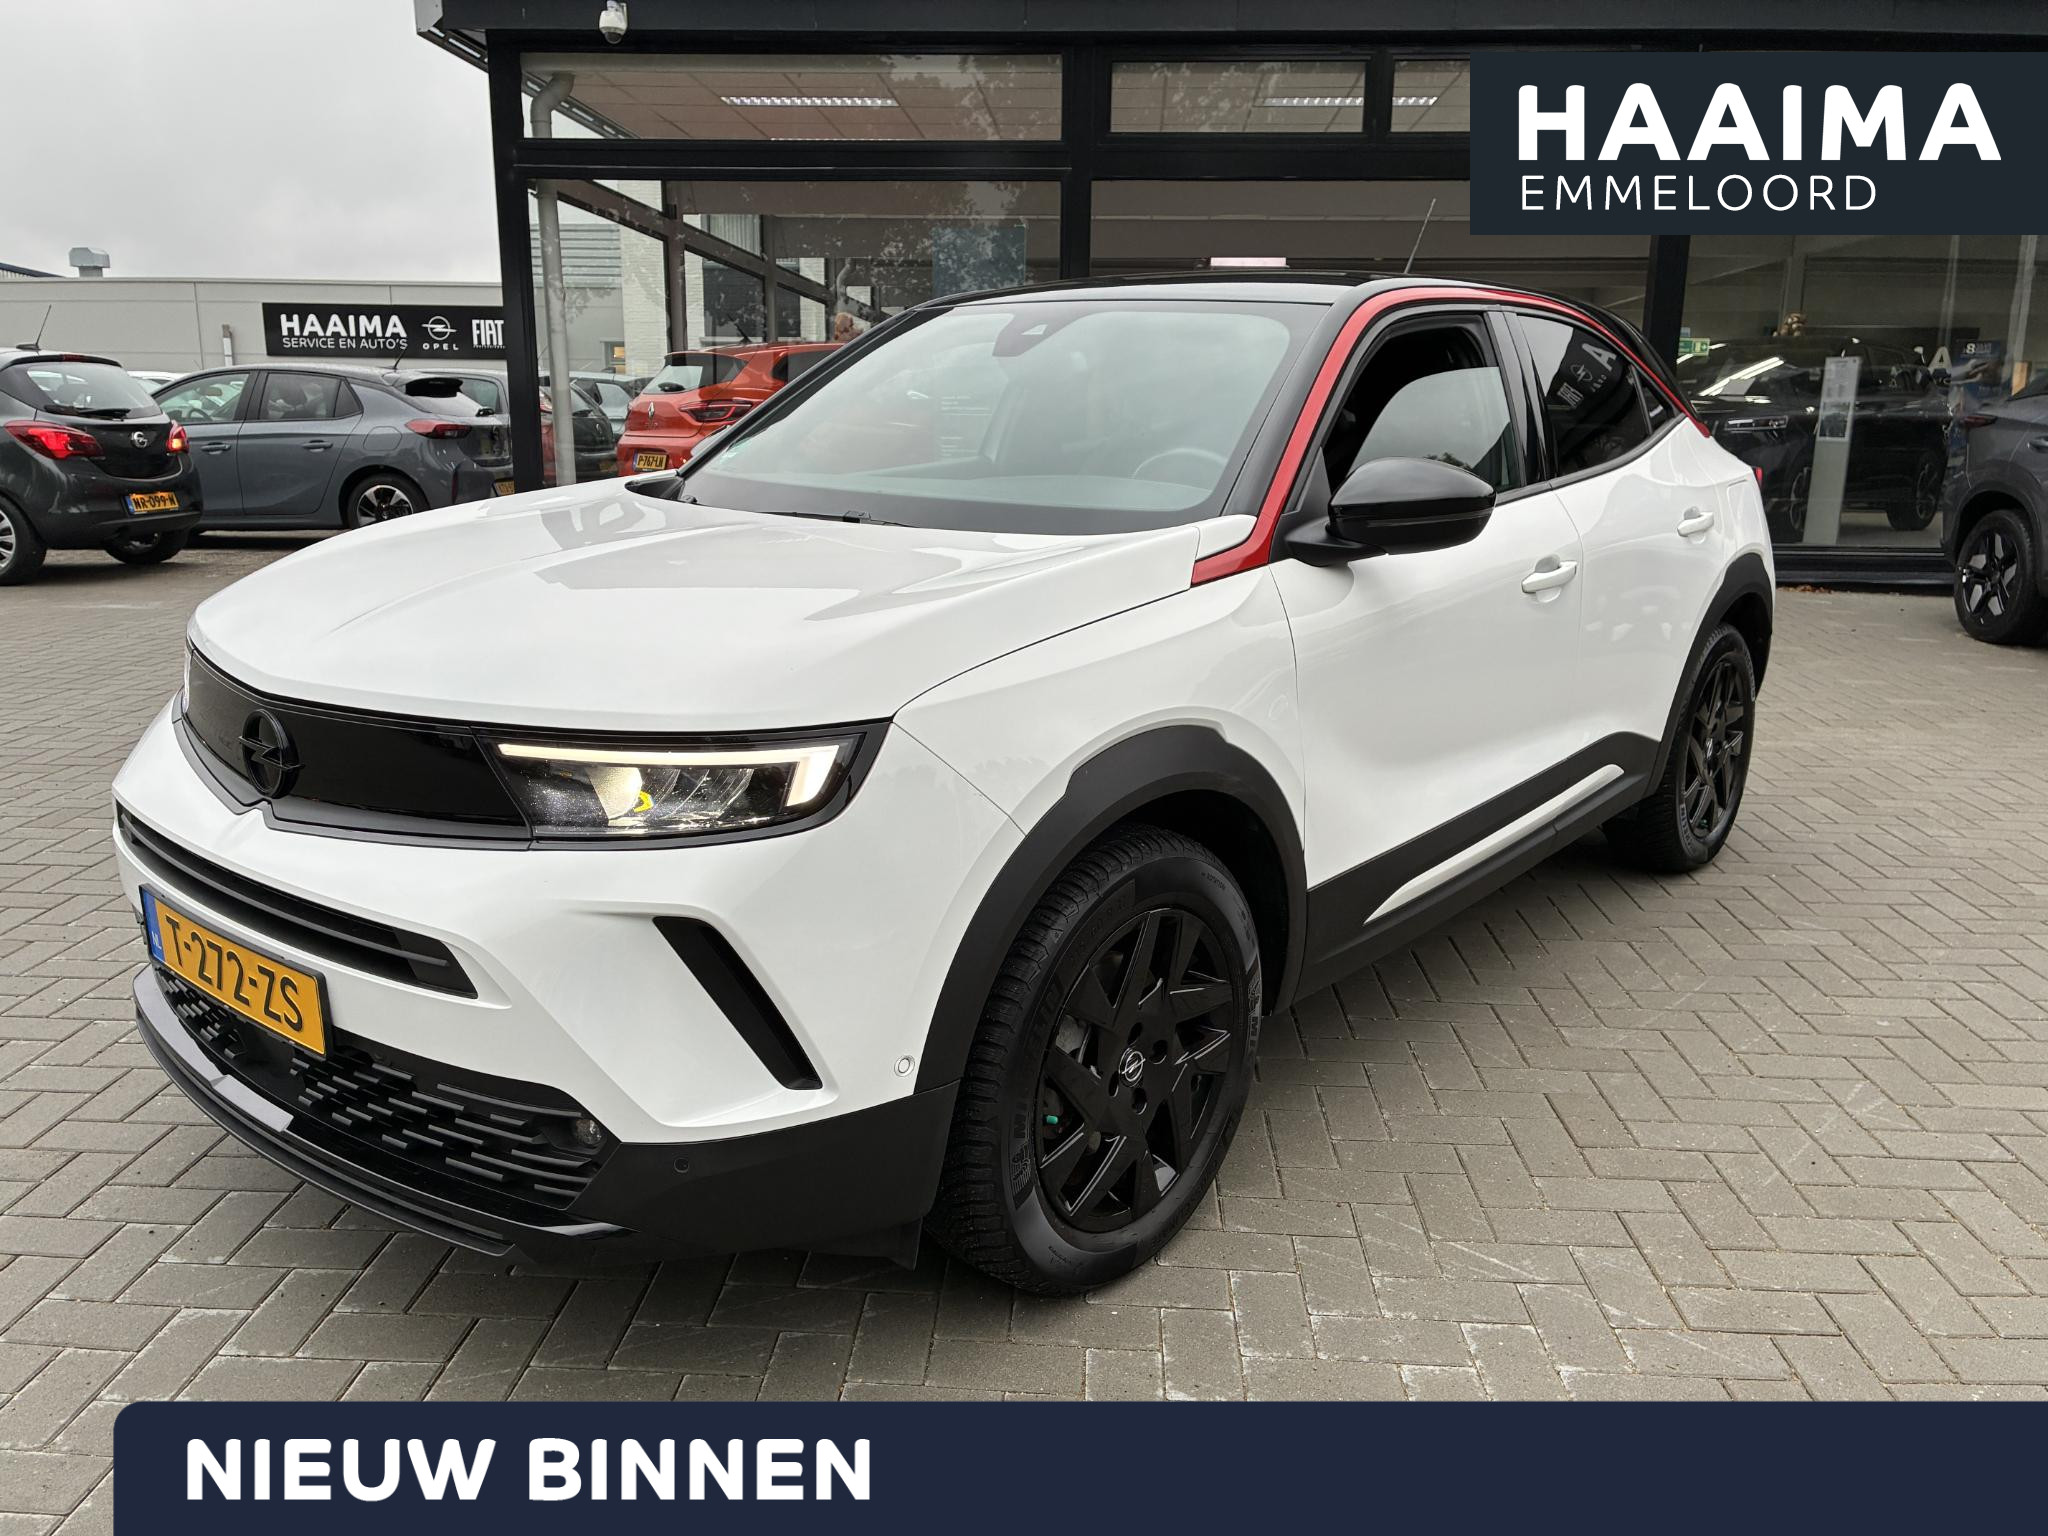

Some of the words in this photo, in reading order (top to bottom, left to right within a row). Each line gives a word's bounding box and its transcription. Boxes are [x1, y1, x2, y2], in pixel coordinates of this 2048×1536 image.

[280, 313, 408, 338] HAAIMA
[471, 319, 505, 346] FIAT
[282, 337, 336, 349] SERVICE
[339, 338, 356, 349] EN
[359, 338, 408, 350] AUTO'S
[422, 342, 460, 351] OPEL
[165, 914, 303, 1032] T-272-ZS
